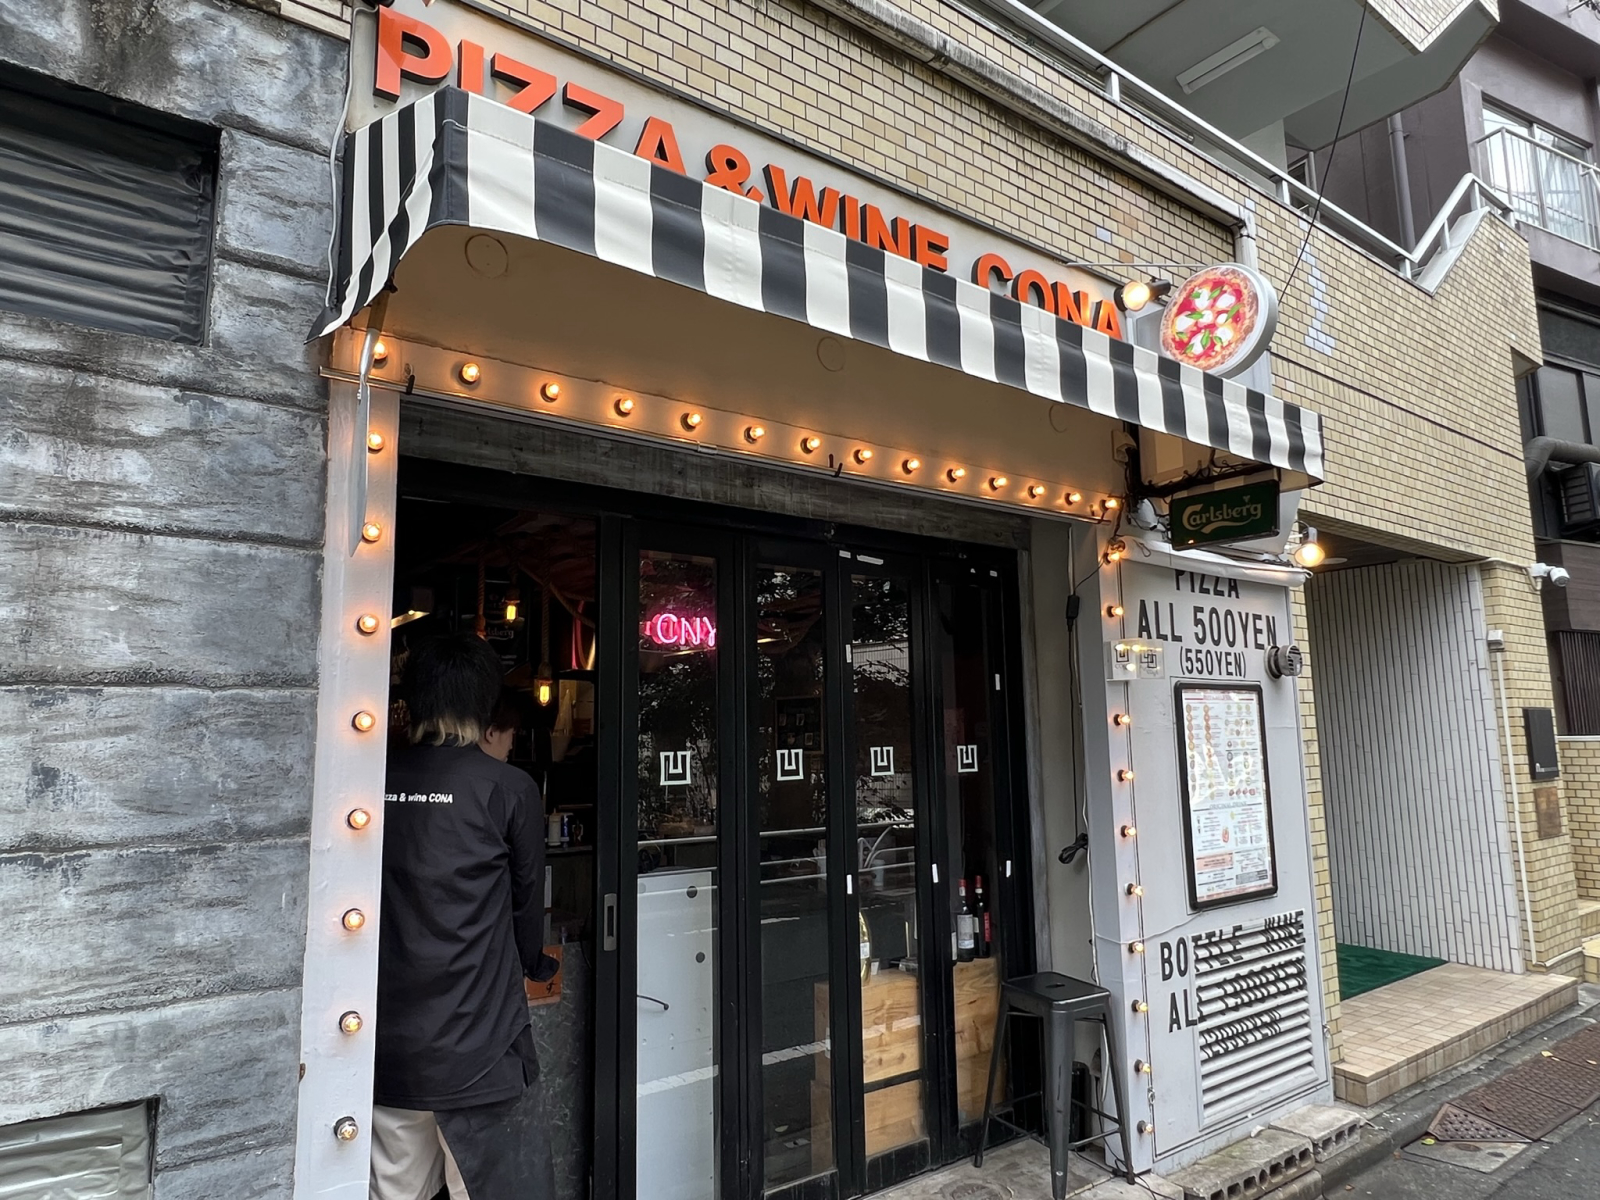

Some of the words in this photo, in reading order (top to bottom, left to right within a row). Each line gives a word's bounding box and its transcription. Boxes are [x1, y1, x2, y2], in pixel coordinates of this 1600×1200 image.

[971, 253, 1122, 340] CONA
[1182, 499, 1262, 532] Carlsberg
[1138, 600, 1183, 643] ALL
[1193, 605, 1277, 651] 500YEN
[1180, 645, 1247, 679] (550YEN)
[399, 792, 407, 803] &
[408, 792, 427, 803] wine
[428, 792, 454, 804] CONA
